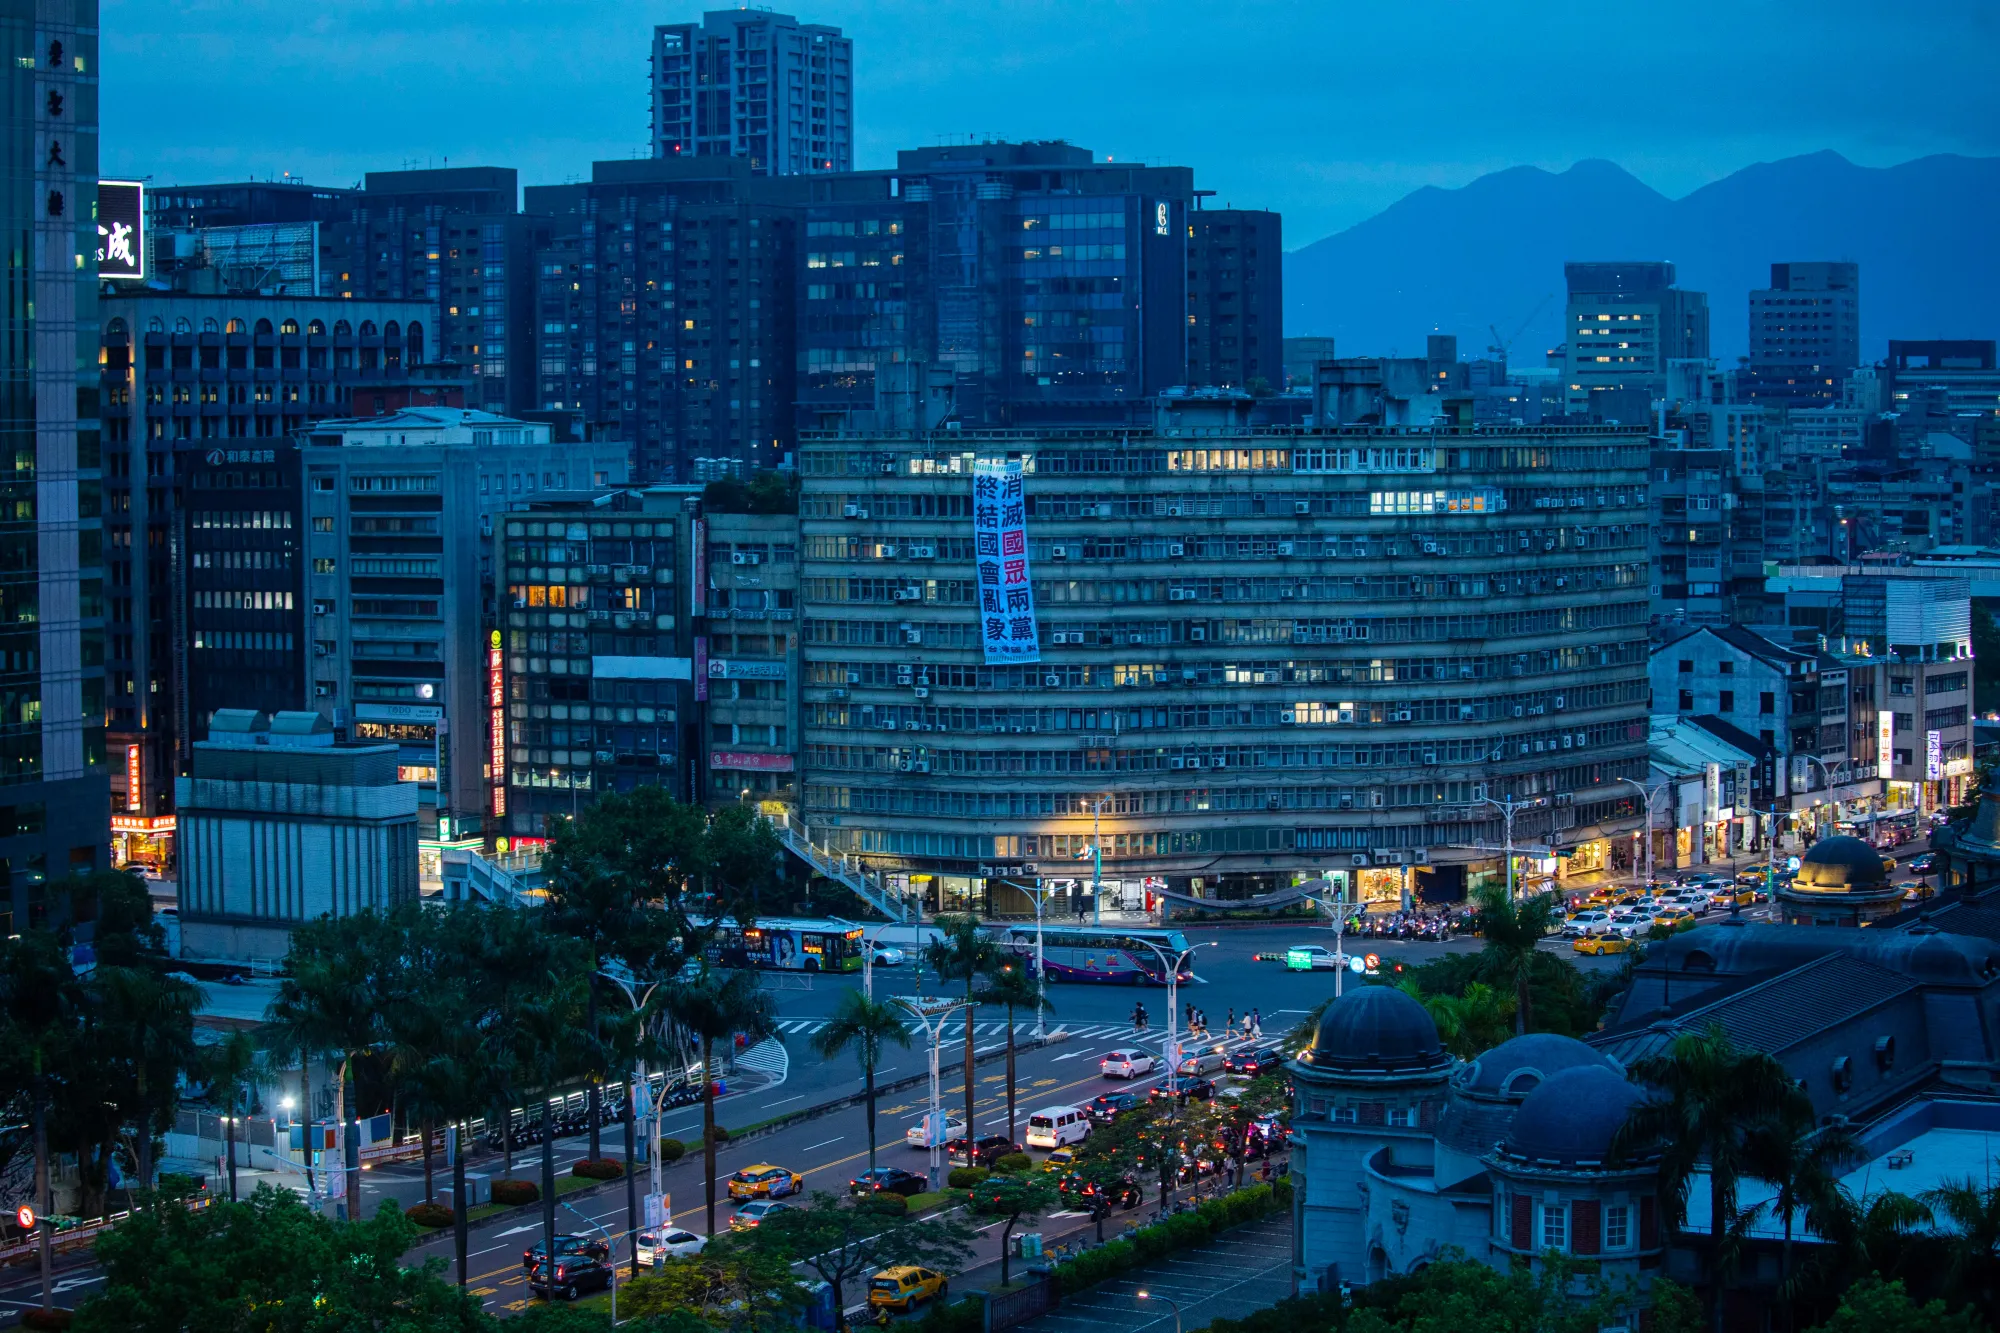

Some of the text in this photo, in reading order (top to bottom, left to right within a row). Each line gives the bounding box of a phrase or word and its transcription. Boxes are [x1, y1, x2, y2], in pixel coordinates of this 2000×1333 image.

[226, 450, 275, 464] 和泰產險
[975, 475, 1008, 641] 終結國會亂象
[1001, 475, 1034, 641] 消滅國眾兩黨
